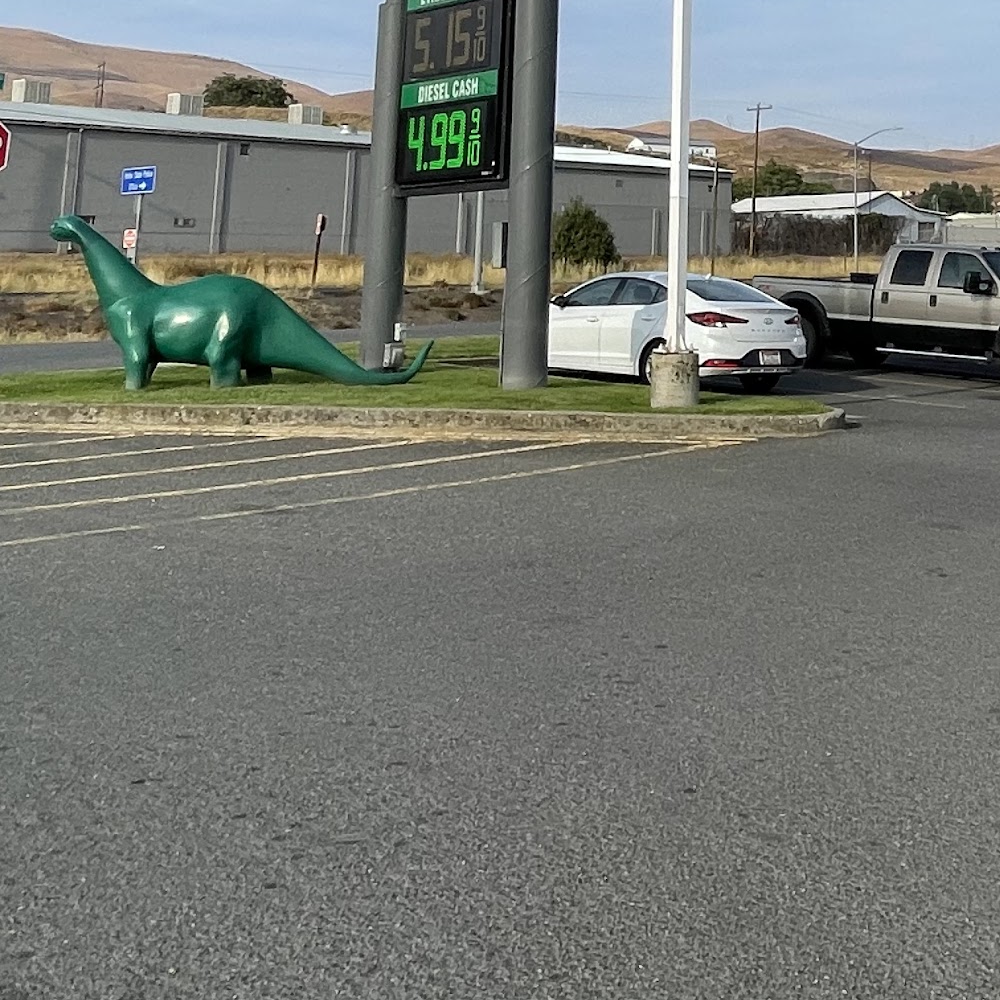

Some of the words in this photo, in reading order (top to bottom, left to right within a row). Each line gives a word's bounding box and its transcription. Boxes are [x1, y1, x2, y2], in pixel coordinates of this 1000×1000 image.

[417, 82, 450, 104] DIESEL
[451, 77, 479, 98] CASH
[408, 110, 467, 172] 4.99
